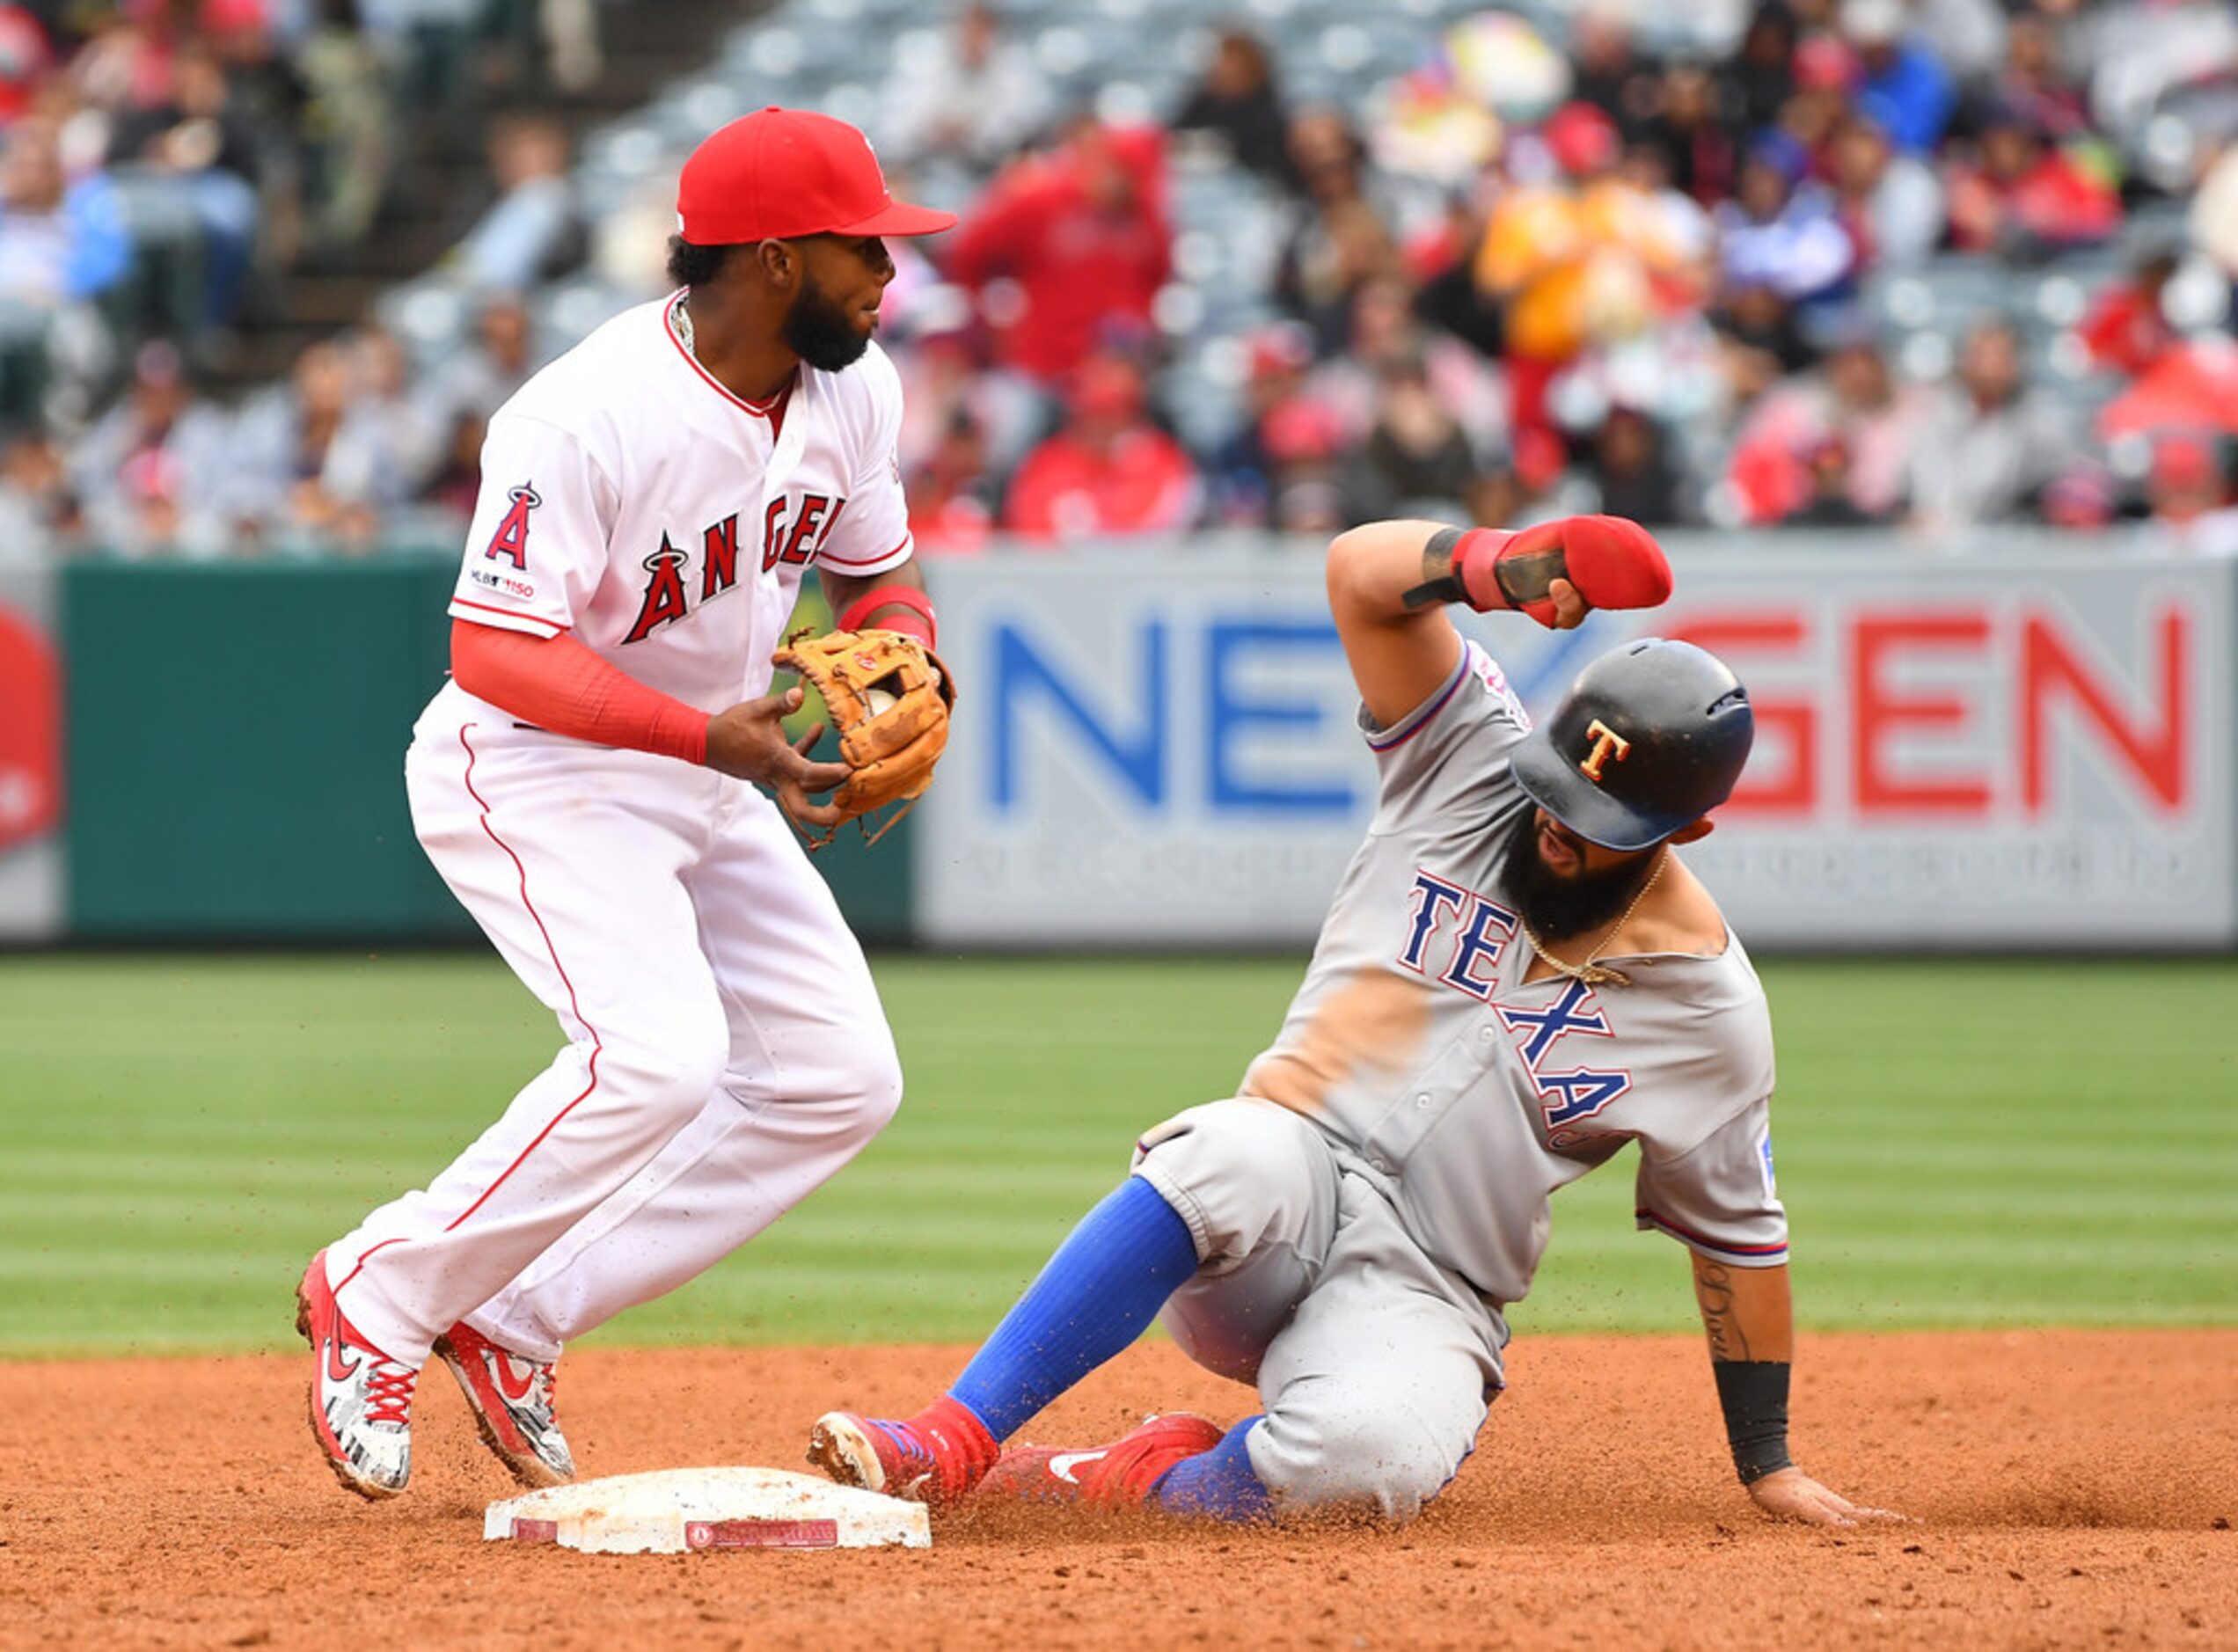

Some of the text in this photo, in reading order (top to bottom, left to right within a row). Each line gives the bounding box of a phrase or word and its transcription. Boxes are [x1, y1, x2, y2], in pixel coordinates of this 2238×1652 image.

[485, 479, 542, 571] A
[1579, 718, 1631, 781] T
[1397, 869, 1633, 1148] TEXA
